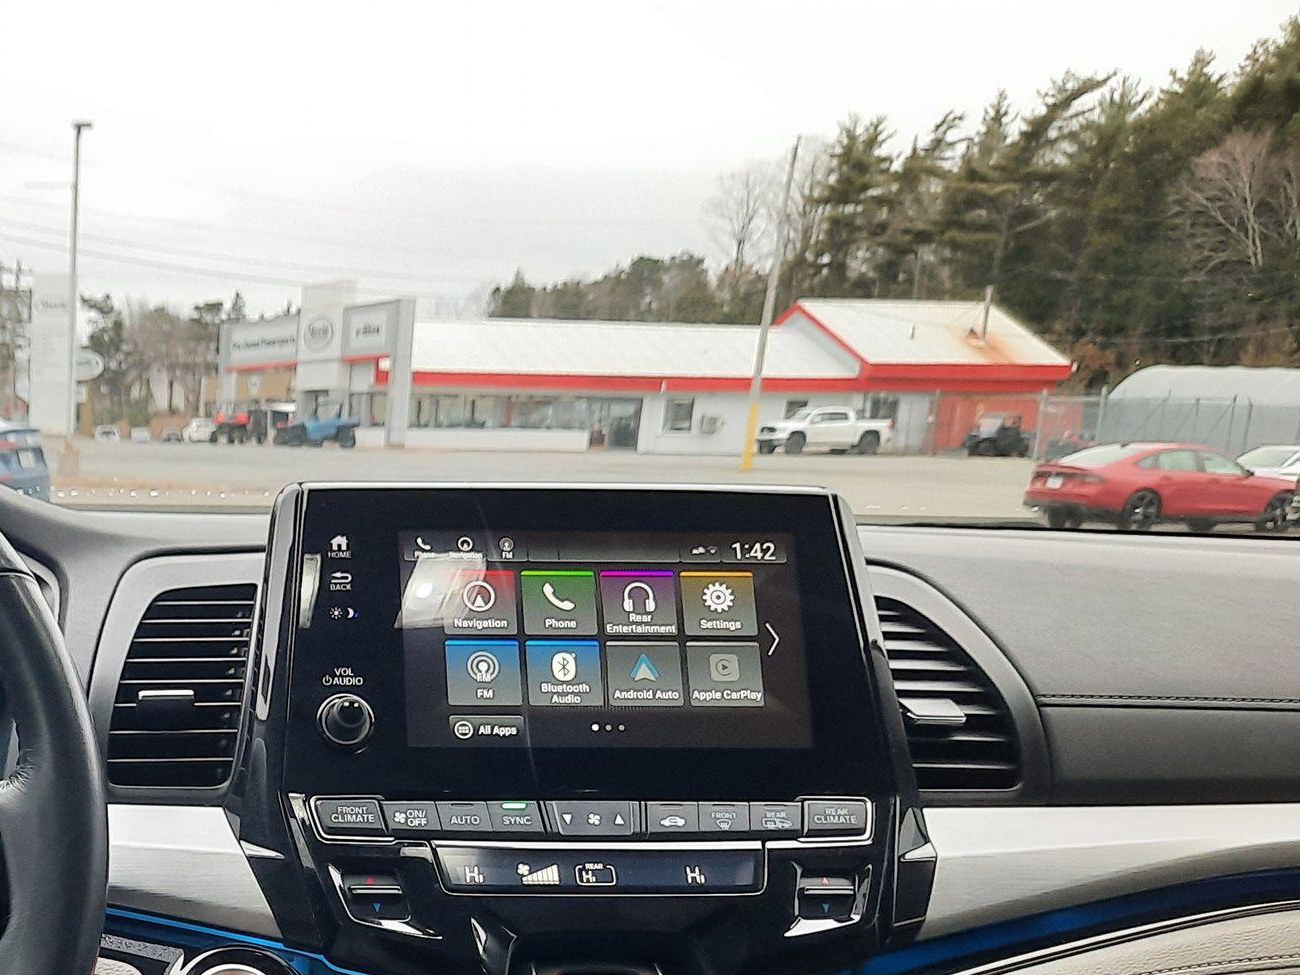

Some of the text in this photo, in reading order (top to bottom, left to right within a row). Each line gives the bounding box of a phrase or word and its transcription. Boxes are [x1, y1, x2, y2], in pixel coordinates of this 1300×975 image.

[328, 551, 351, 559] HOME
[502, 551, 513, 559] FM
[731, 542, 777, 560] 1:42
[330, 583, 351, 591] BACK
[545, 618, 577, 628] Phone
[629, 613, 652, 623] Rear
[454, 618, 508, 630] Navigation
[606, 624, 676, 634] Entertainment
[700, 619, 742, 631] Settings
[334, 667, 354, 676] VOL
[332, 677, 364, 686] AUDIO
[541, 683, 590, 694] Bluetooth
[476, 689, 493, 699] FM
[551, 694, 581, 704] Audio
[614, 689, 679, 700] Android Auto
[692, 690, 762, 702] Apple CarPlay
[478, 725, 518, 737] All Apps
[337, 806, 367, 815] FRONT
[407, 809, 426, 819] ON/
[765, 811, 787, 819] REAR
[824, 808, 850, 816] REAR
[331, 814, 375, 824] CLIMATE
[450, 815, 480, 825] AUTO
[503, 815, 532, 826] SYNC
[711, 812, 737, 820] FRONT
[814, 815, 858, 825] CLIMATE
[407, 818, 428, 827] OFF
[585, 862, 604, 870] REAR
